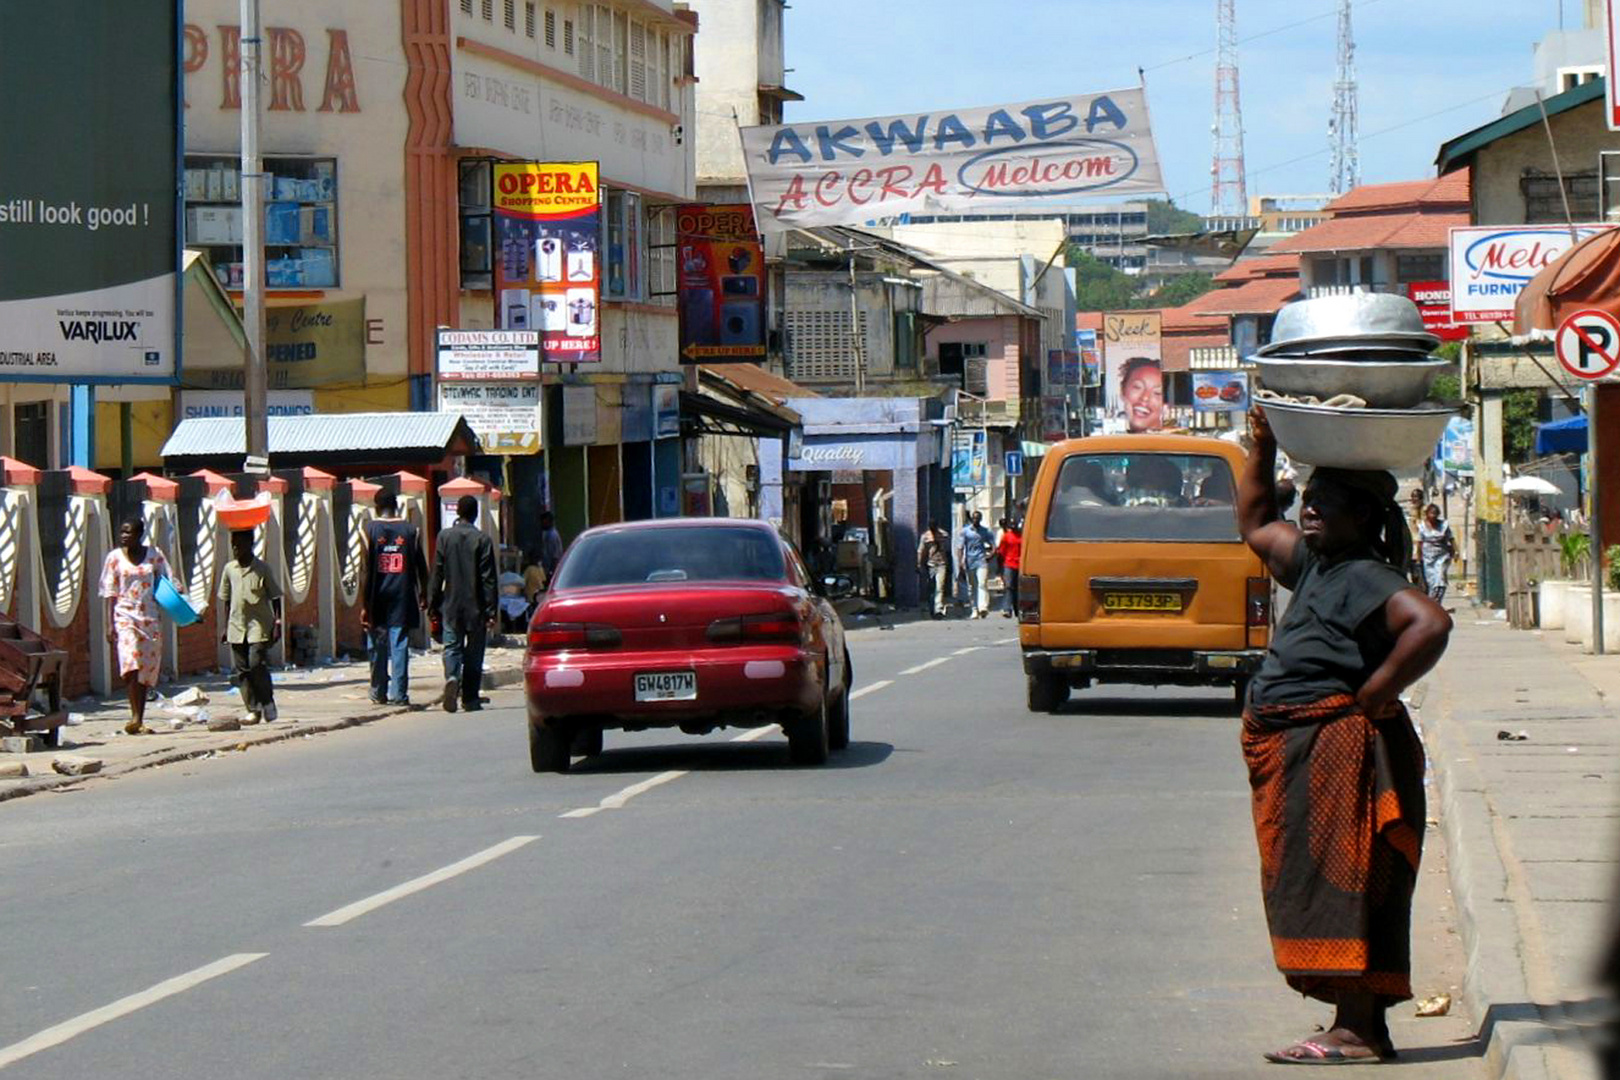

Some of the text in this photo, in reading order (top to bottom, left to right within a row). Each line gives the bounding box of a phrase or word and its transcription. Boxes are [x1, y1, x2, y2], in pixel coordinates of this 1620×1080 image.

[766, 94, 1128, 165] AKWAABA
[498, 171, 595, 194] OPERA
[969, 154, 1118, 197] Melcom
[774, 162, 948, 216] ACCRA
[0, 200, 33, 222] still
[40, 200, 82, 224] look
[87, 203, 137, 230] good
[60, 321, 137, 344] VARILUX
[1106, 316, 1157, 342] Sleek
[1579, 325, 1611, 368] P
[801, 446, 865, 465] Quality
[1105, 594, 1173, 608] GT3793P
[637, 674, 693, 691] GW4817W
